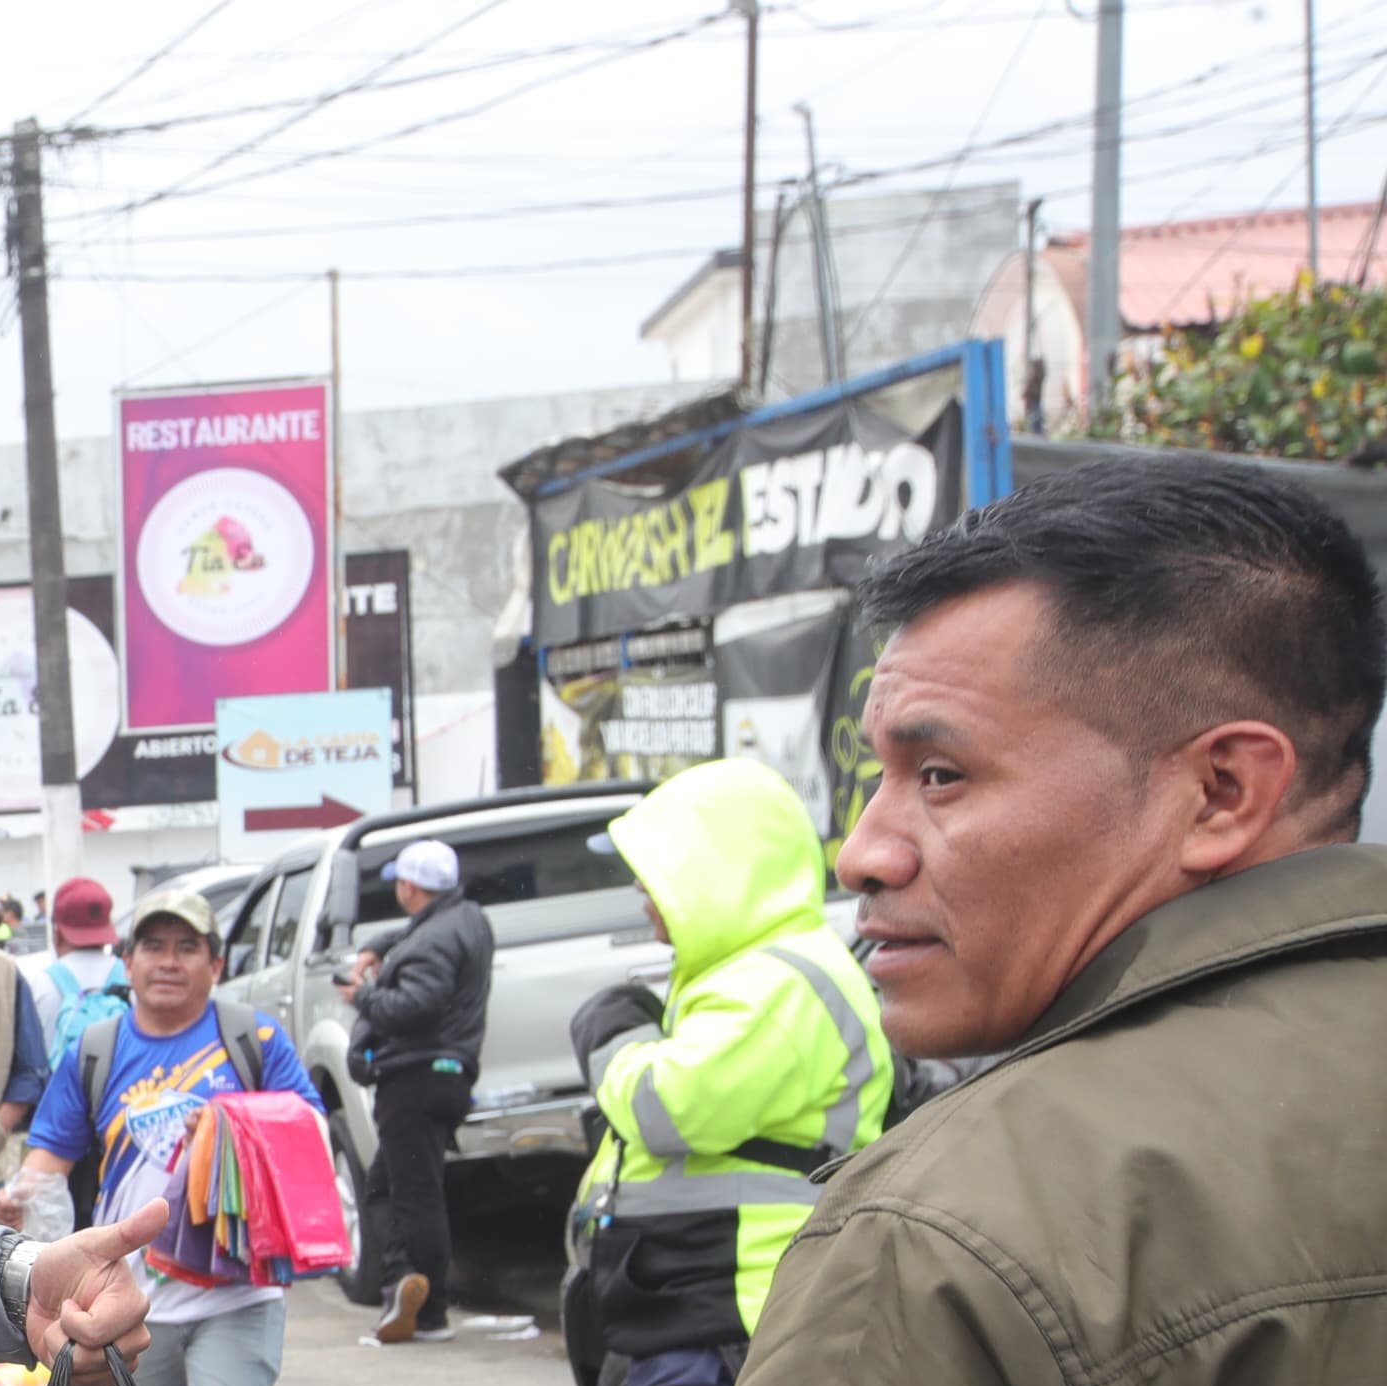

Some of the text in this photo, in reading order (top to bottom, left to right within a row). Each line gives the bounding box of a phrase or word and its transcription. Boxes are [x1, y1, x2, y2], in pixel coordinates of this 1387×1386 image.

[127, 409, 320, 452] RESTAURANTE
[548, 502, 690, 605] CARWASH
[343, 582, 398, 616] TE
[285, 745, 379, 764] DE TEJA
